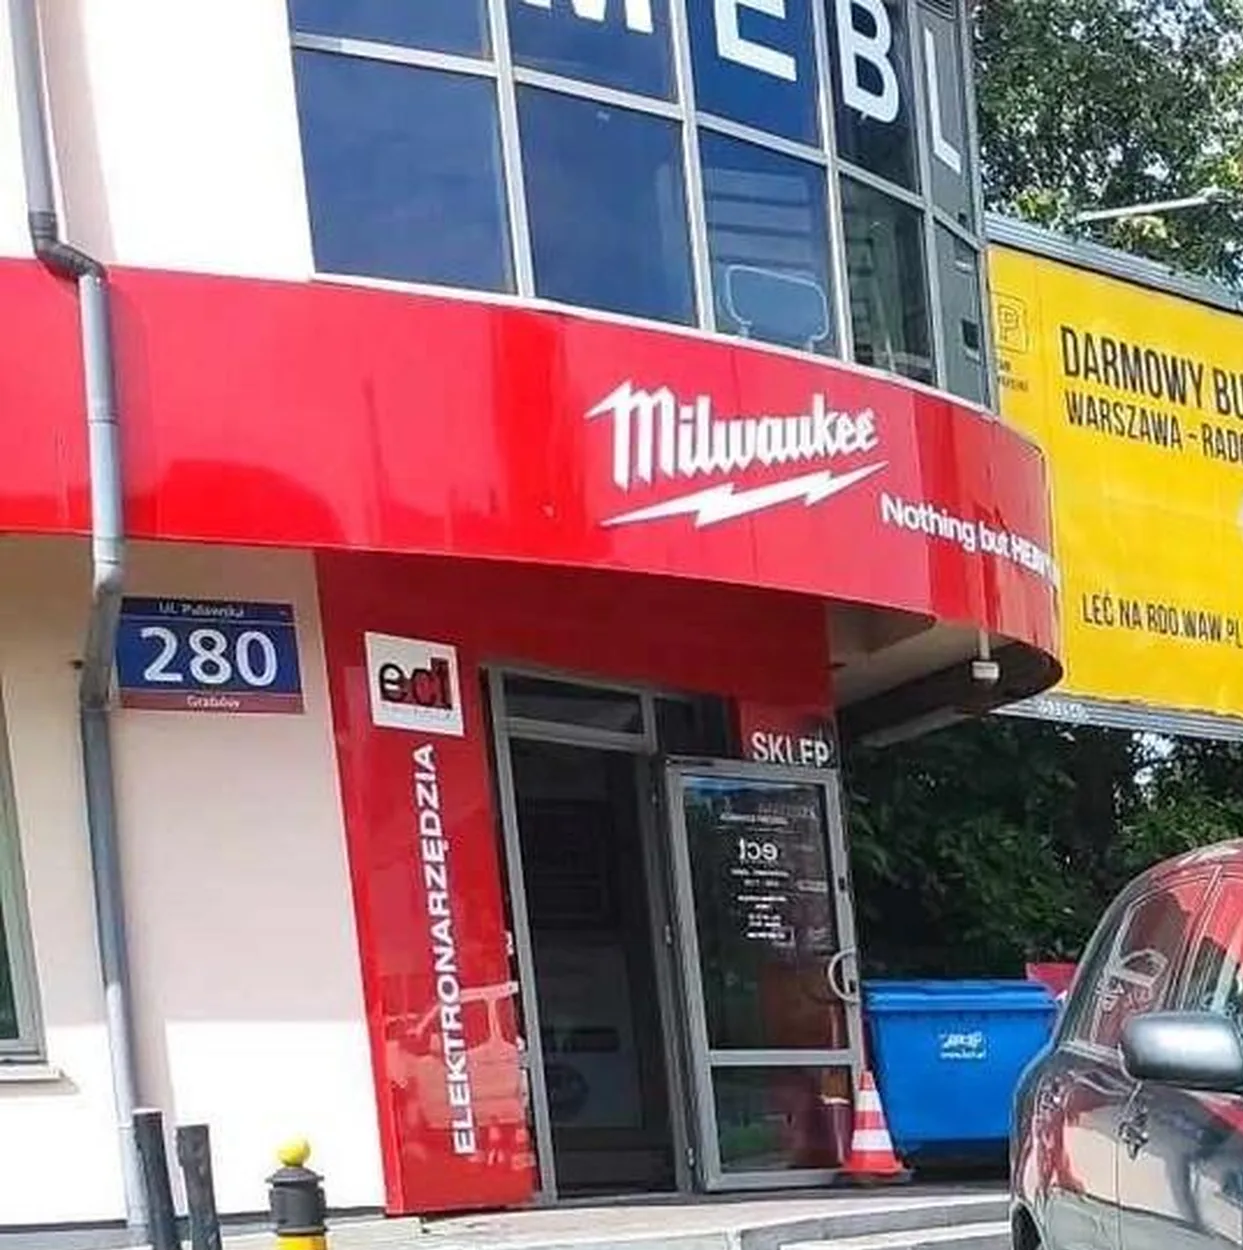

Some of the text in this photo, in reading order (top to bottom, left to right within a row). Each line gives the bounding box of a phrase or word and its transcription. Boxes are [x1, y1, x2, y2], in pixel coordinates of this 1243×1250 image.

[523, 0, 962, 174] EBL
[1060, 325, 1204, 409] DARMOWY
[584, 377, 878, 492] Milwaukee
[1065, 391, 1184, 451] WARSZAWA
[880, 492, 976, 552] Nothing
[979, 520, 1009, 558] but
[1118, 597, 1143, 630] NA
[140, 625, 278, 687] 280
[751, 731, 830, 769] SKLEP
[403, 743, 476, 1156] ELEKTRONARZĘDZIA
